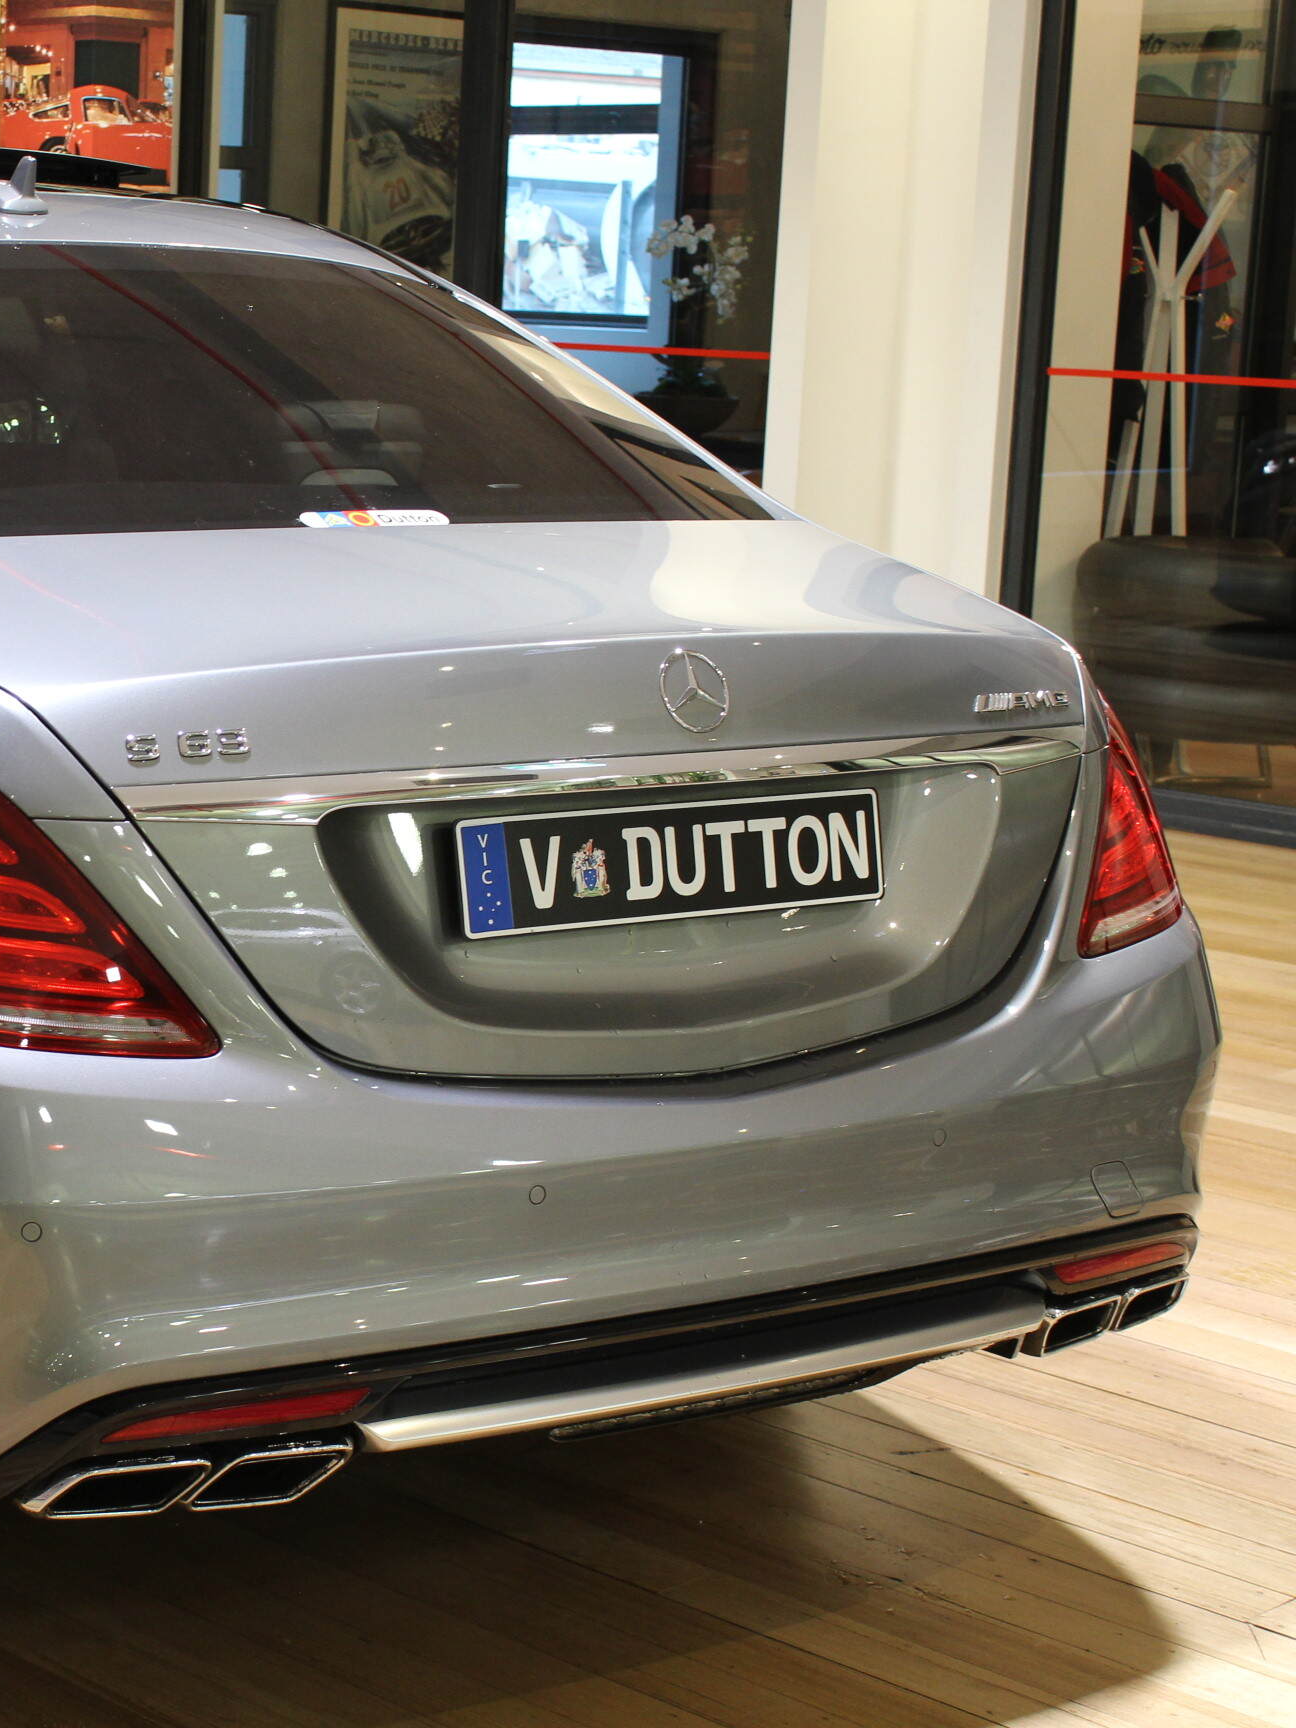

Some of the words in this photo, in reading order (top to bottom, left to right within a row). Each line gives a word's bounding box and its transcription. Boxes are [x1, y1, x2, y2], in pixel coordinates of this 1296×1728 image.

[125, 733, 160, 761] S
[177, 728, 251, 757] 63
[476, 833, 494, 885] VIC
[519, 835, 561, 909] V
[621, 809, 870, 901] DUTTON
